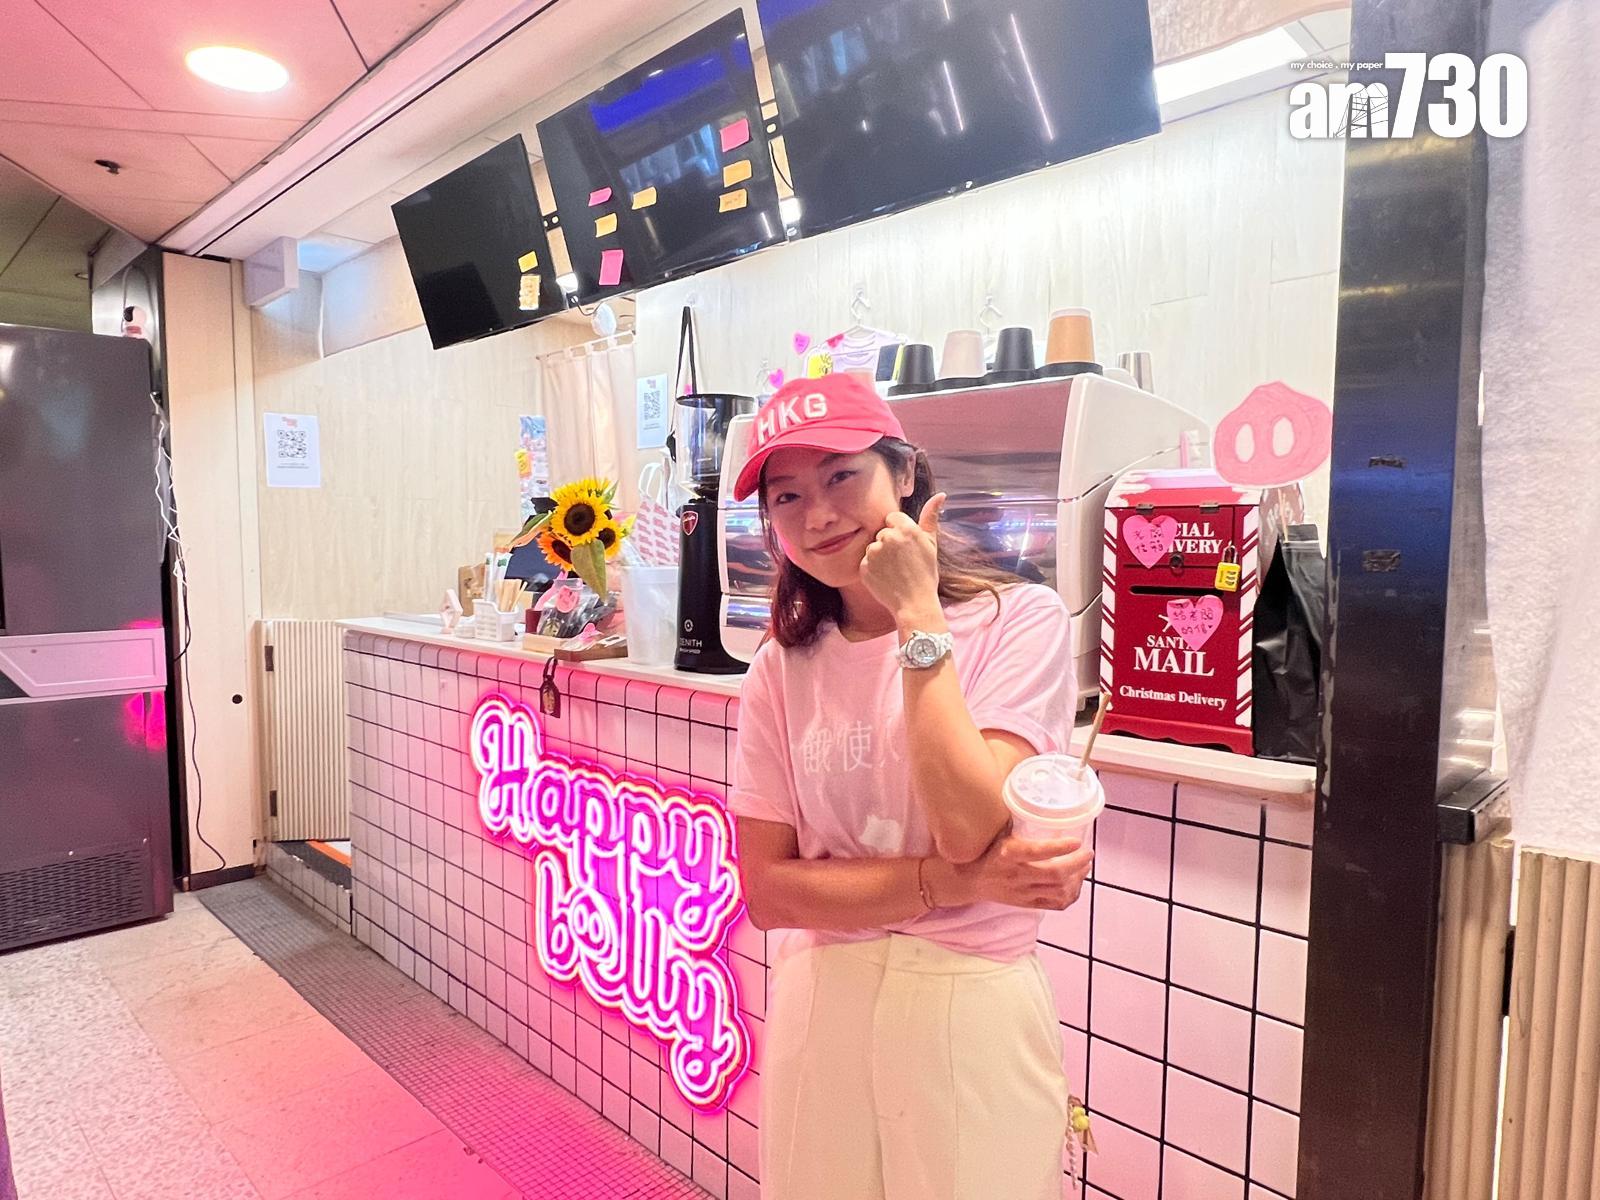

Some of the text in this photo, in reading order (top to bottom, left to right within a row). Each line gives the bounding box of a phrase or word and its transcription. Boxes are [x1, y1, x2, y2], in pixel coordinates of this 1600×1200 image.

[758, 392, 828, 446] HKG
[1146, 634, 1190, 650] SANT
[1133, 646, 1215, 677] MAIL
[1119, 685, 1228, 710] Christmas Delivery
